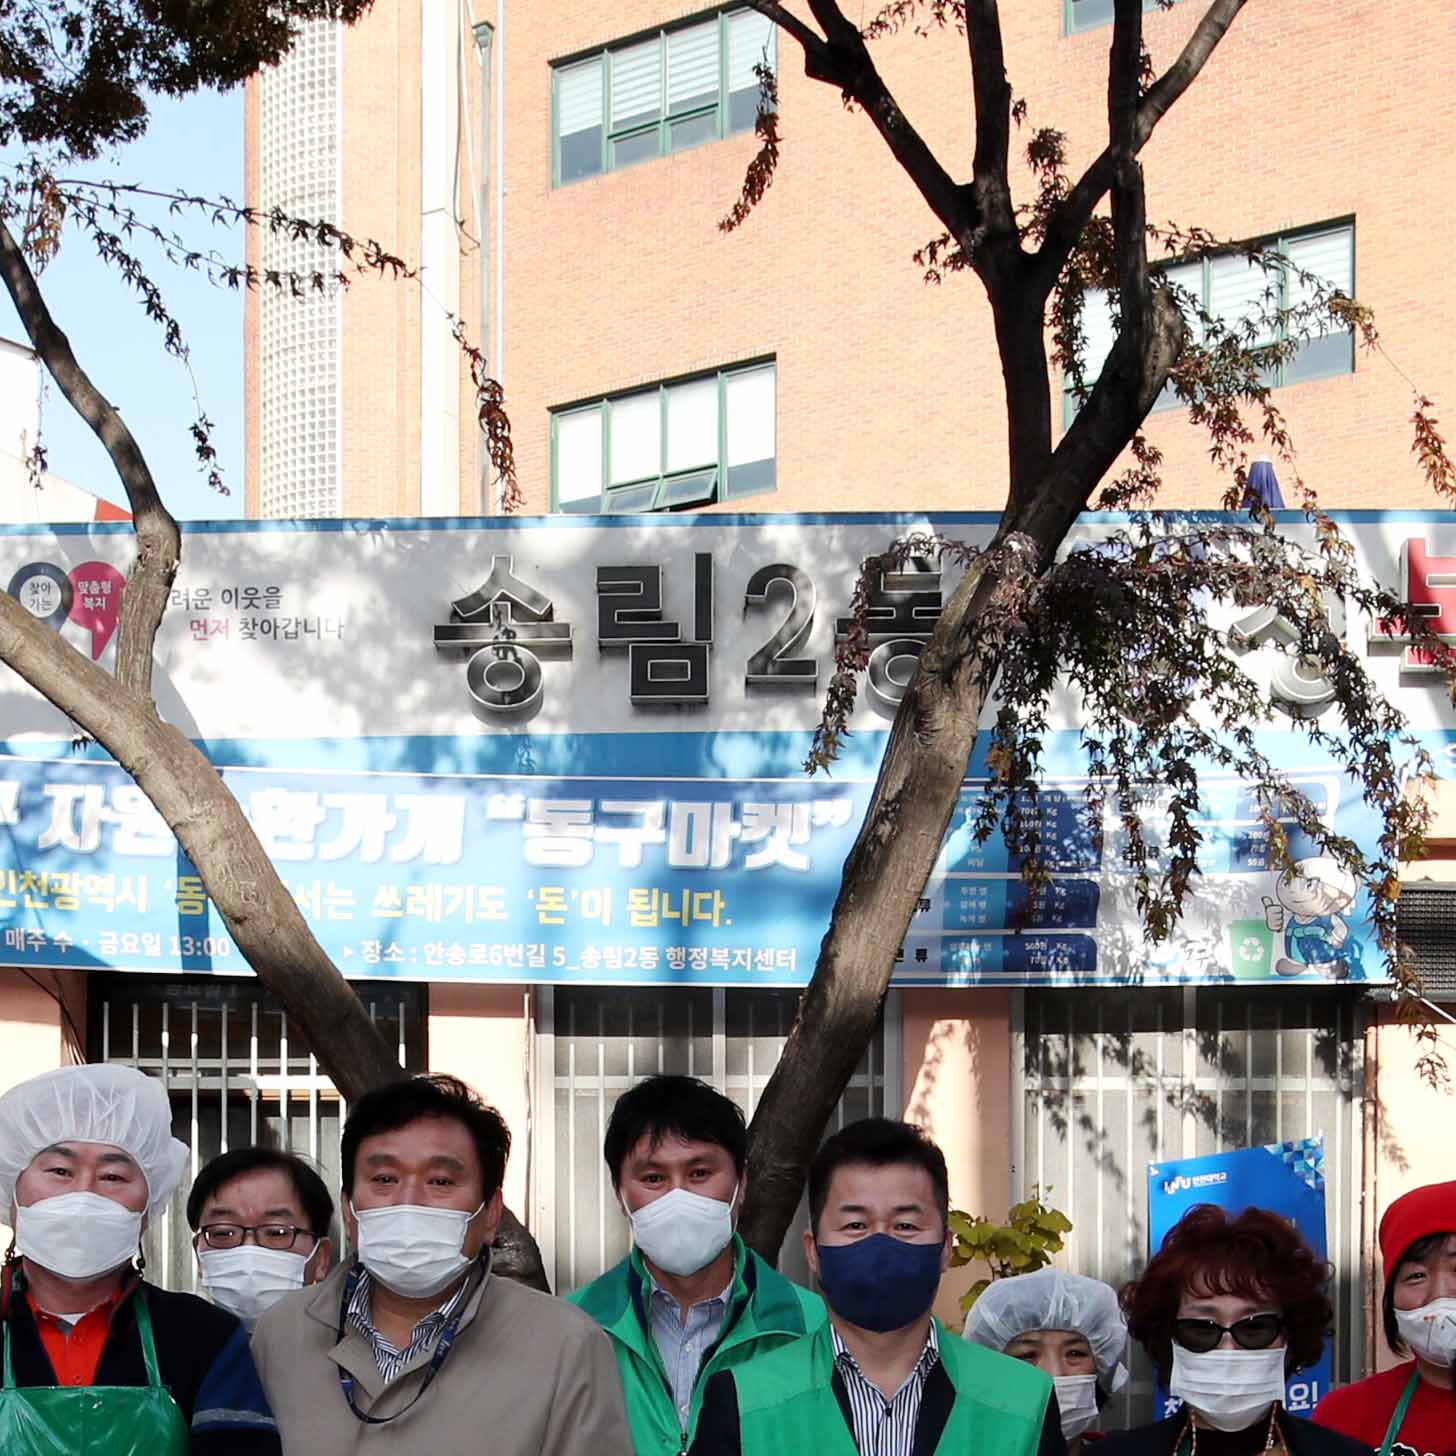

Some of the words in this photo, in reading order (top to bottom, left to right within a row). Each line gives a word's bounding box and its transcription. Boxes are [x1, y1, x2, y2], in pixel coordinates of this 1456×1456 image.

[170, 587, 212, 610] 려운
[220, 585, 284, 610] 이웃을
[189, 616, 230, 641] 먼저
[239, 616, 345, 641] 찾아갑니다
[433, 553, 949, 715] 송림2동
[36, 782, 466, 866] 자원환가게
[370, 883, 509, 924] 쓰레기도
[625, 887, 734, 928] 됩니다.
[4, 927, 48, 953] 매주
[53, 929, 75, 954] 수
[97, 931, 163, 958] 금요일
[168, 935, 231, 958] 13:00
[360, 939, 406, 965] 장소
[423, 941, 545, 968] 안송로6번길
[665, 944, 798, 972] 행정복지센터
